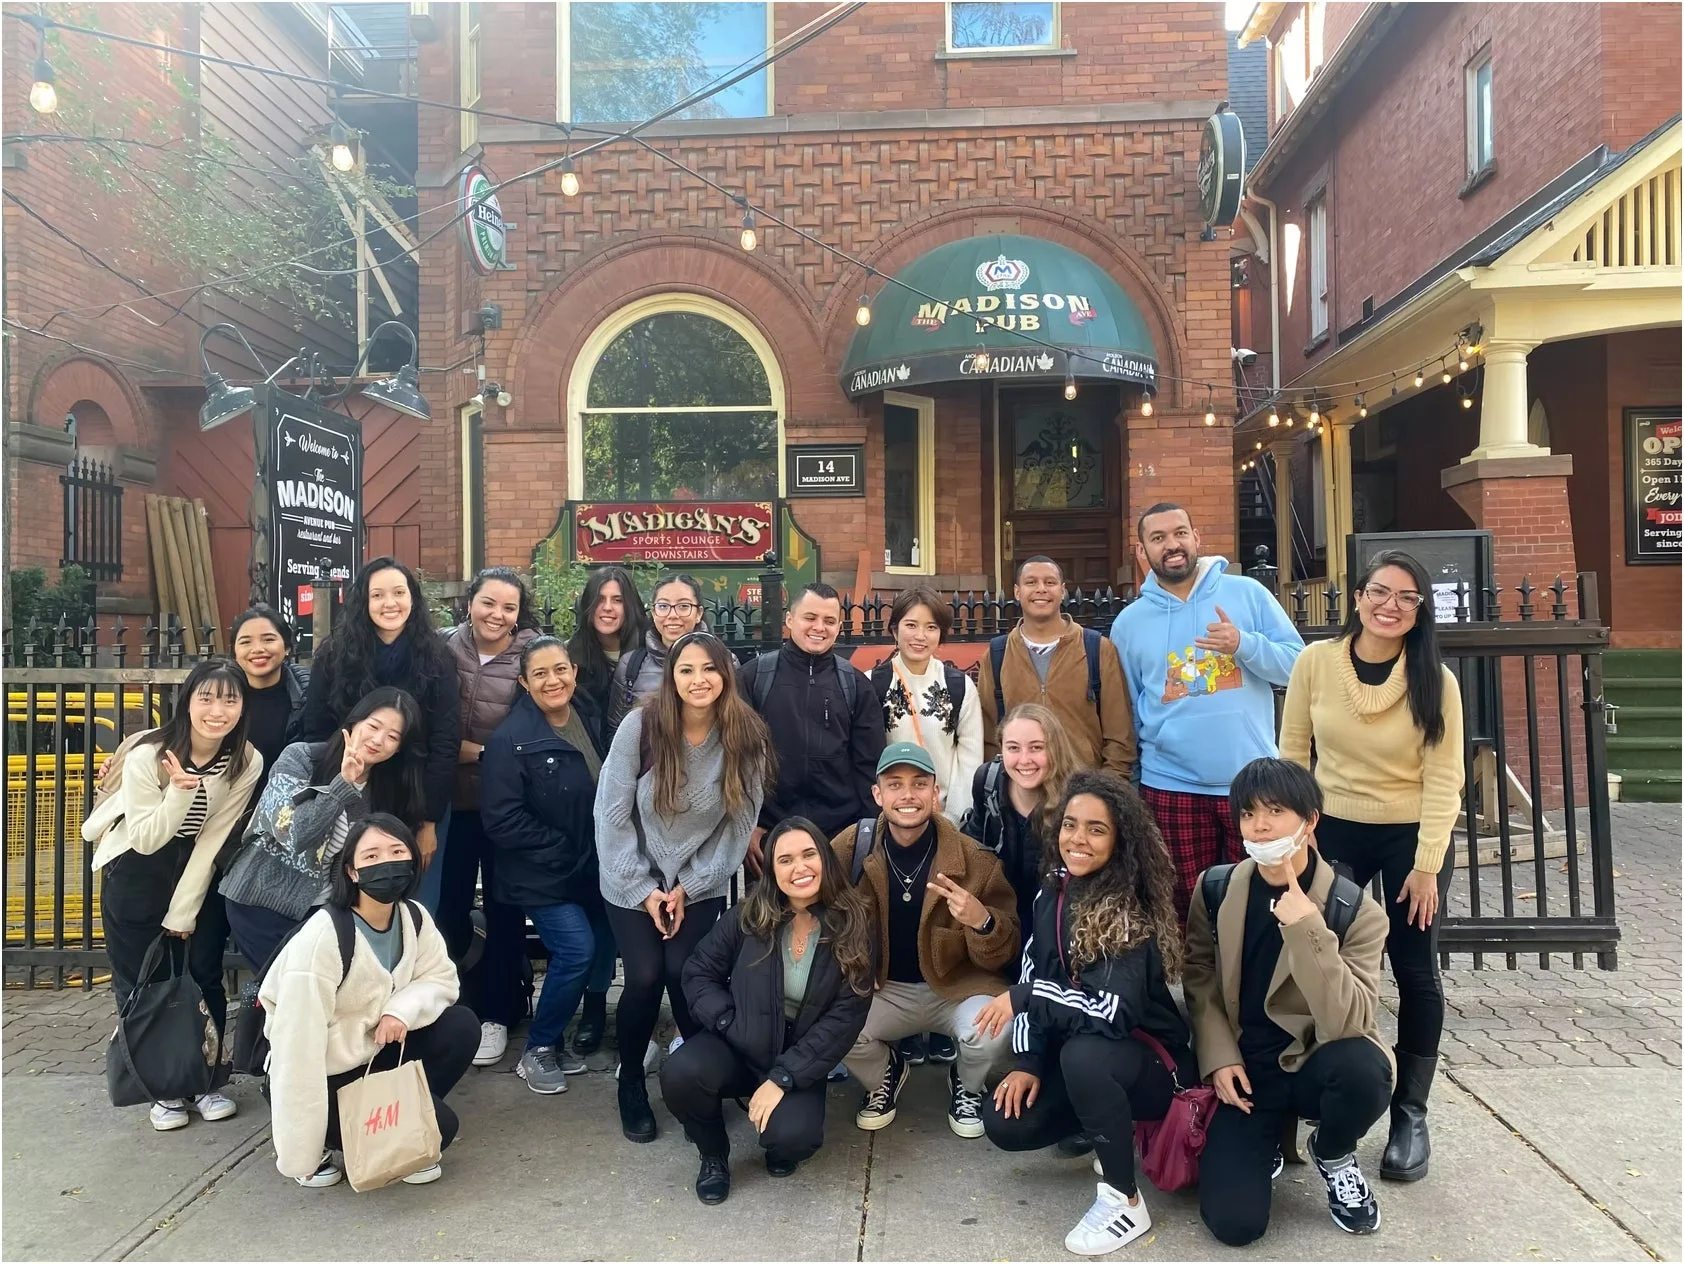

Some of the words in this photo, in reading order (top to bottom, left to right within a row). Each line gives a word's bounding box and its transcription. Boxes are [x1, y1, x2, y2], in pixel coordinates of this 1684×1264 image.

[918, 293, 1090, 324] MADISON
[916, 318, 938, 326] THE
[975, 314, 1041, 333] PUB
[851, 367, 896, 391] CANADIAN
[1660, 425, 1682, 434] Welc
[298, 432, 331, 457] Welcome
[331, 445, 339, 459] to
[1643, 437, 1682, 454] OP
[818, 460, 835, 473] 14
[1645, 458, 1661, 466] 365
[314, 468, 325, 482] The
[1642, 475, 1671, 486] Open
[277, 480, 355, 523] MADISON
[303, 516, 324, 528] AVENUE
[324, 519, 335, 531] PUB
[1660, 513, 1682, 523] JOI
[579, 507, 770, 547] MADIGAN'S
[1644, 529, 1682, 538] Serving
[632, 536, 672, 545] SPORTS
[676, 536, 721, 545] LOUNGE
[644, 550, 709, 560] DOWNSTAIRS
[287, 559, 319, 579] Serving
[746, 588, 762, 596] STE
[364, 1100, 400, 1136] H&M
